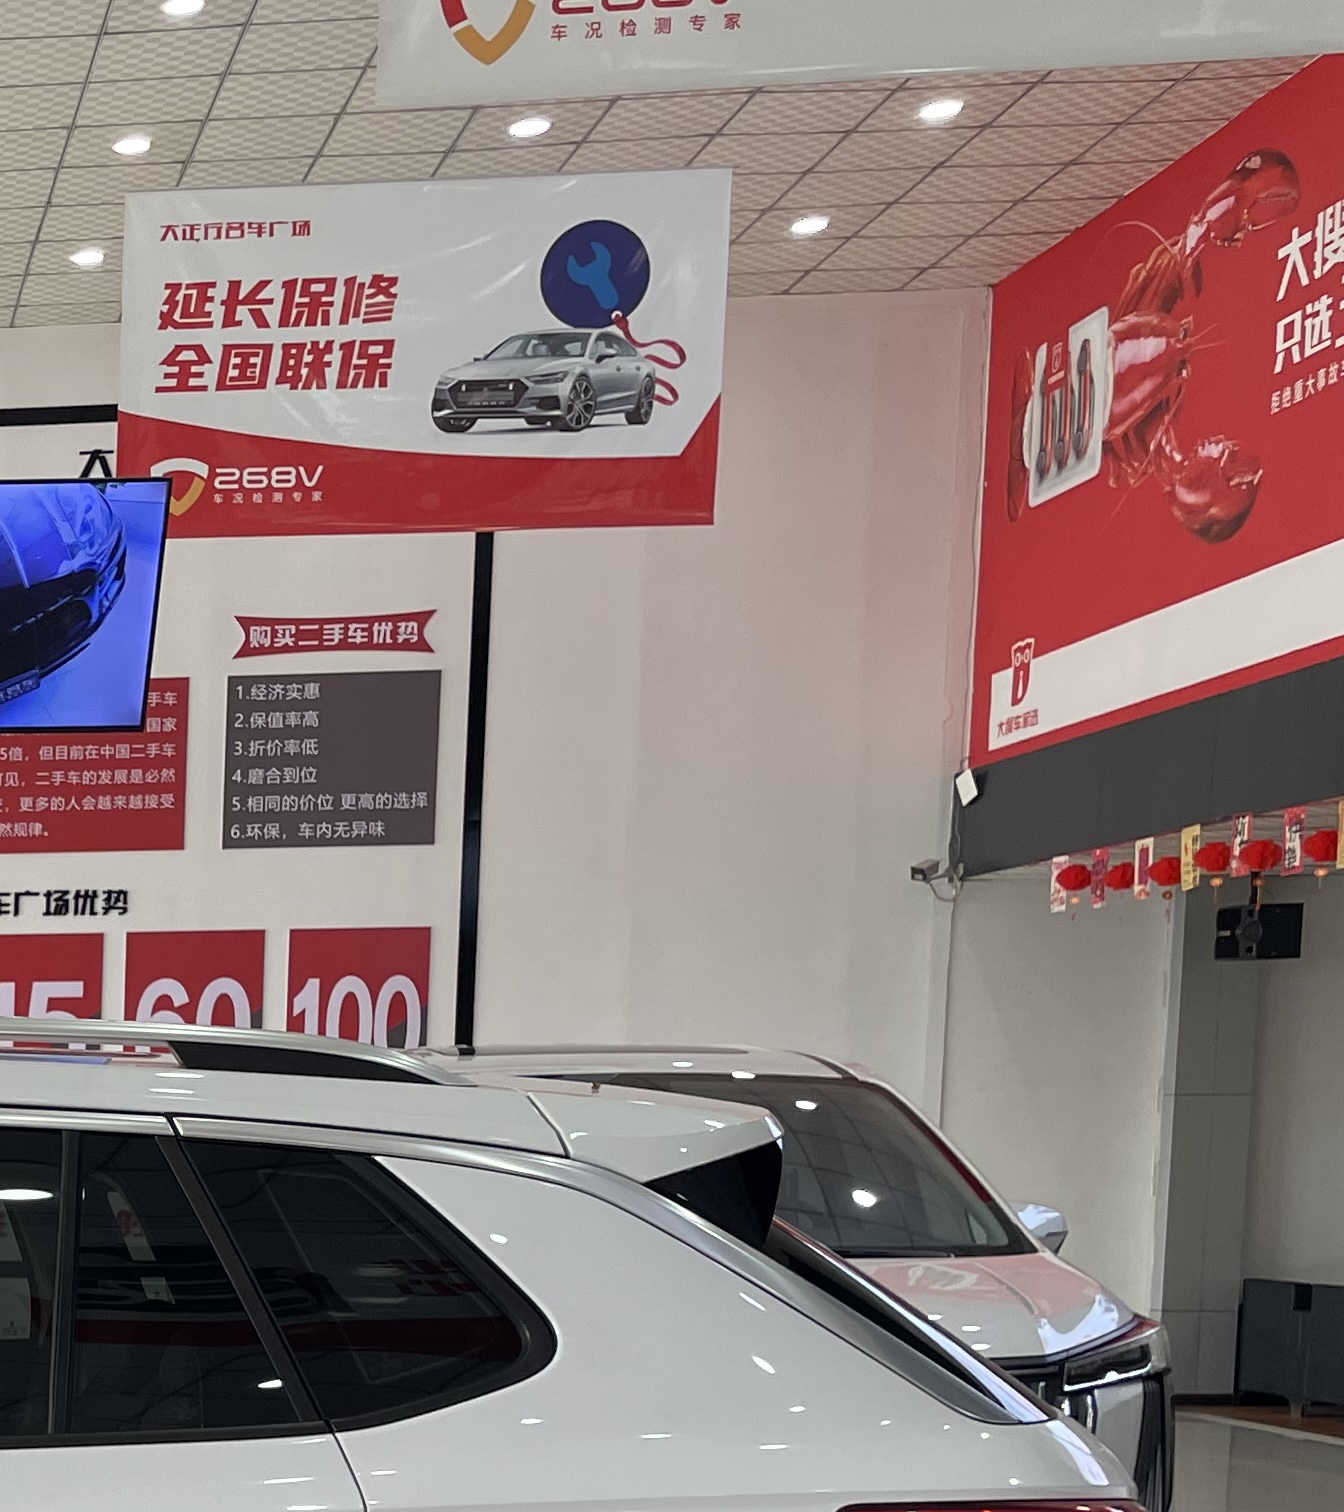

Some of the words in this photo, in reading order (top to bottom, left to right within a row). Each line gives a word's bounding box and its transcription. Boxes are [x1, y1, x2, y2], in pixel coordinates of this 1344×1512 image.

[550, 13, 741, 41] 车况检测专家
[160, 220, 311, 243] 大正行名车广场
[158, 274, 399, 330] 延长保修
[155, 338, 395, 394] 全国联保
[213, 465, 324, 489] 268V
[249, 622, 418, 648] 购买二手车优势
[236, 682, 320, 700] 1.经济实惠
[234, 711, 319, 729] 2.保值率高
[233, 739, 319, 757] 3.折价率低
[232, 766, 318, 785] 4.磨合到位
[232, 794, 334, 812] 5.相同的价位
[340, 792, 428, 810] 更高的选择
[293, 974, 421, 1048] 100
